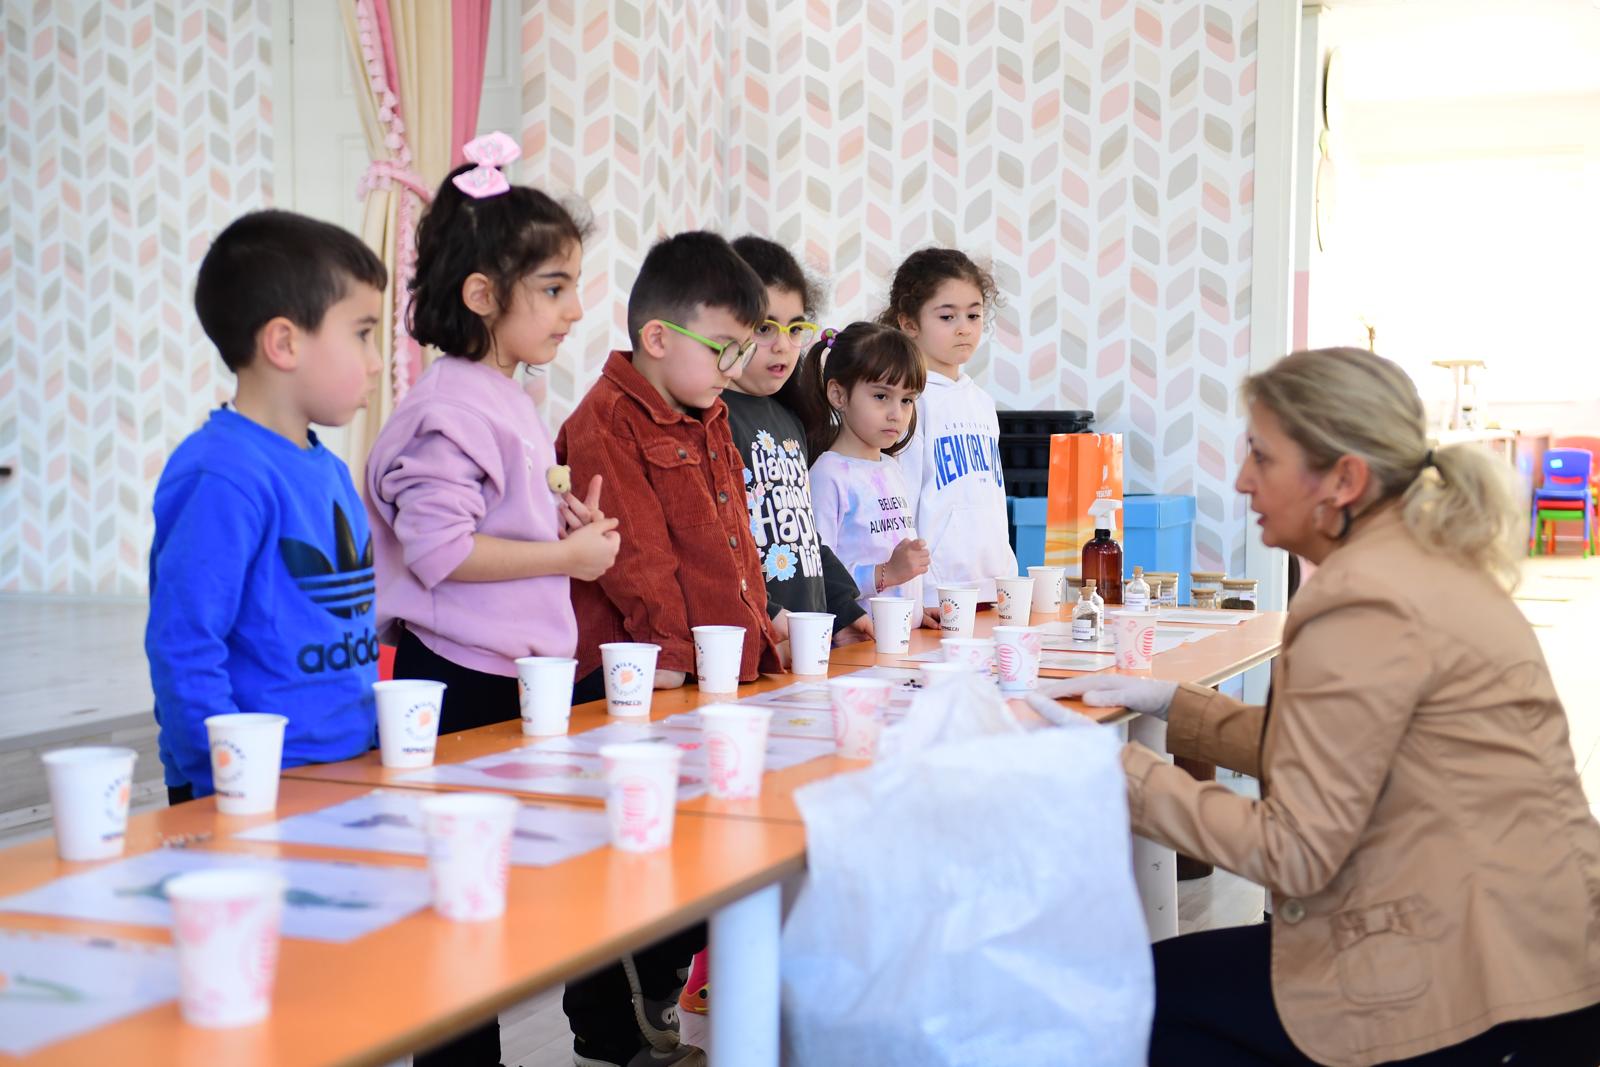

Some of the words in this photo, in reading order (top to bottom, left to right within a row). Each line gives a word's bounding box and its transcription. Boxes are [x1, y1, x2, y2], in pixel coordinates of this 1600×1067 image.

[751, 449, 807, 487] Happy
[934, 433, 968, 490] NEW
[870, 517, 900, 534] ALWAYS
